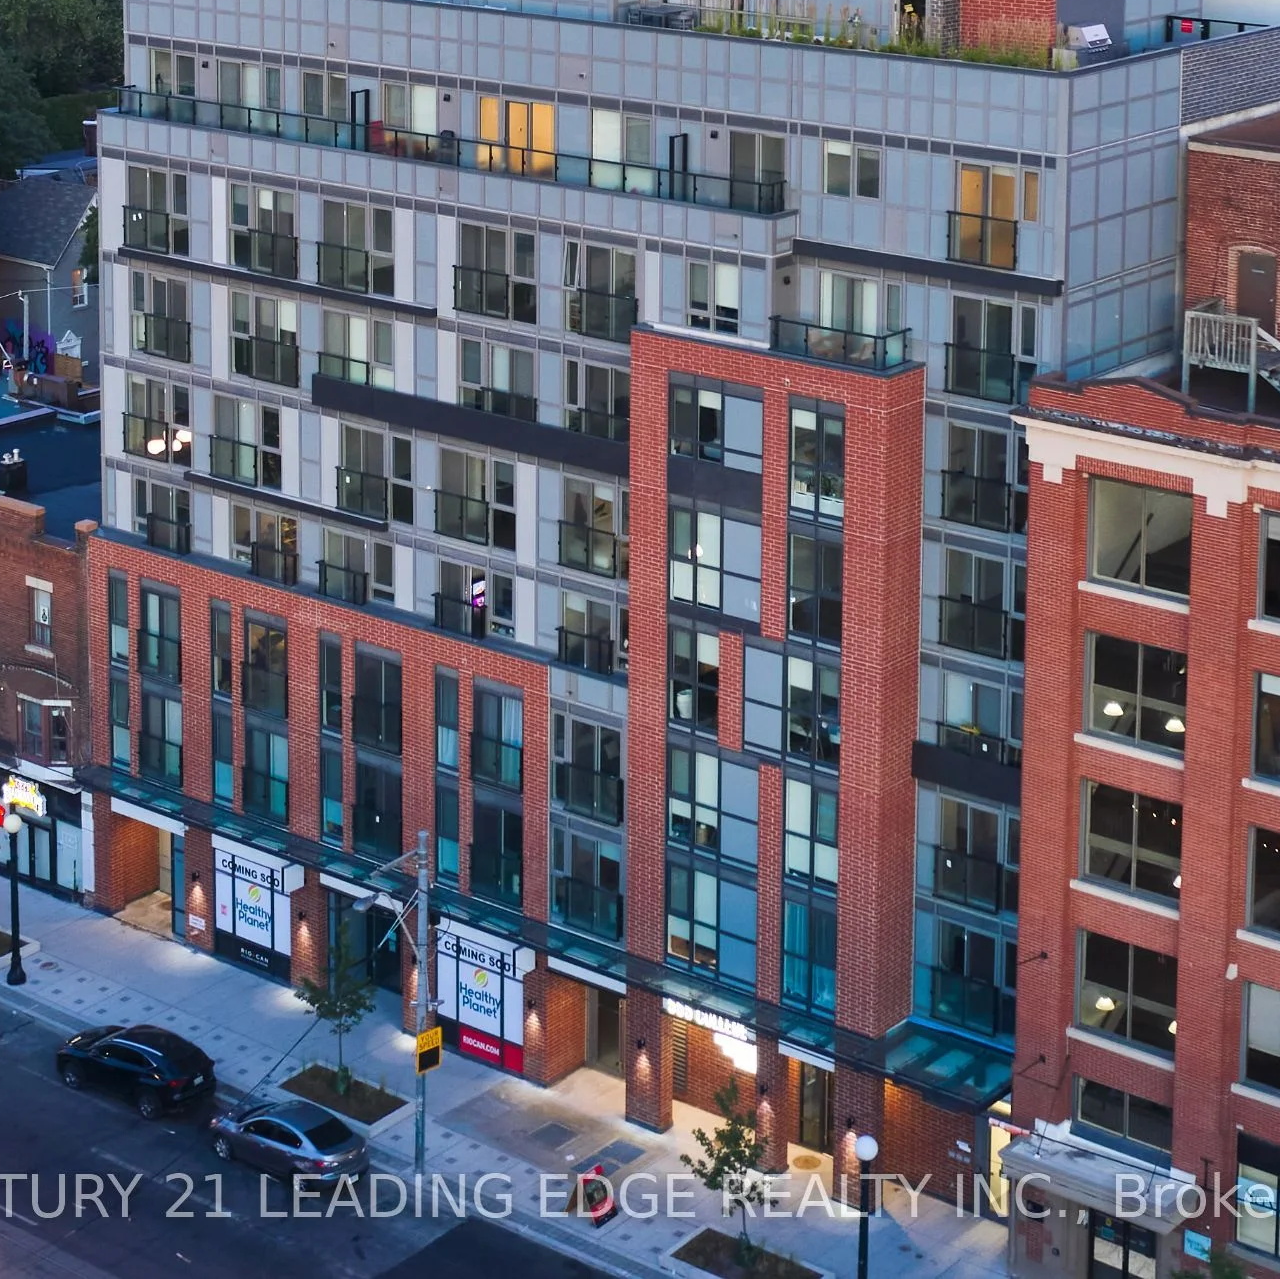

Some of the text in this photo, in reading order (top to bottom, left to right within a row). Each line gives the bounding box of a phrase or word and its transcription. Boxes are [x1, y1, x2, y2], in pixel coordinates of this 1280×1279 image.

[221, 859, 280, 888] COMING SOO
[235, 897, 272, 922] Healthy
[238, 910, 270, 933] Planet
[444, 940, 511, 973] COMING SOO
[459, 982, 501, 1010] Healthy
[462, 995, 498, 1019] Planet
[419, 1038, 440, 1052] SPEED
[420, 1029, 440, 1042] YOUR
[462, 1035, 500, 1057] RIOCAN.COM
